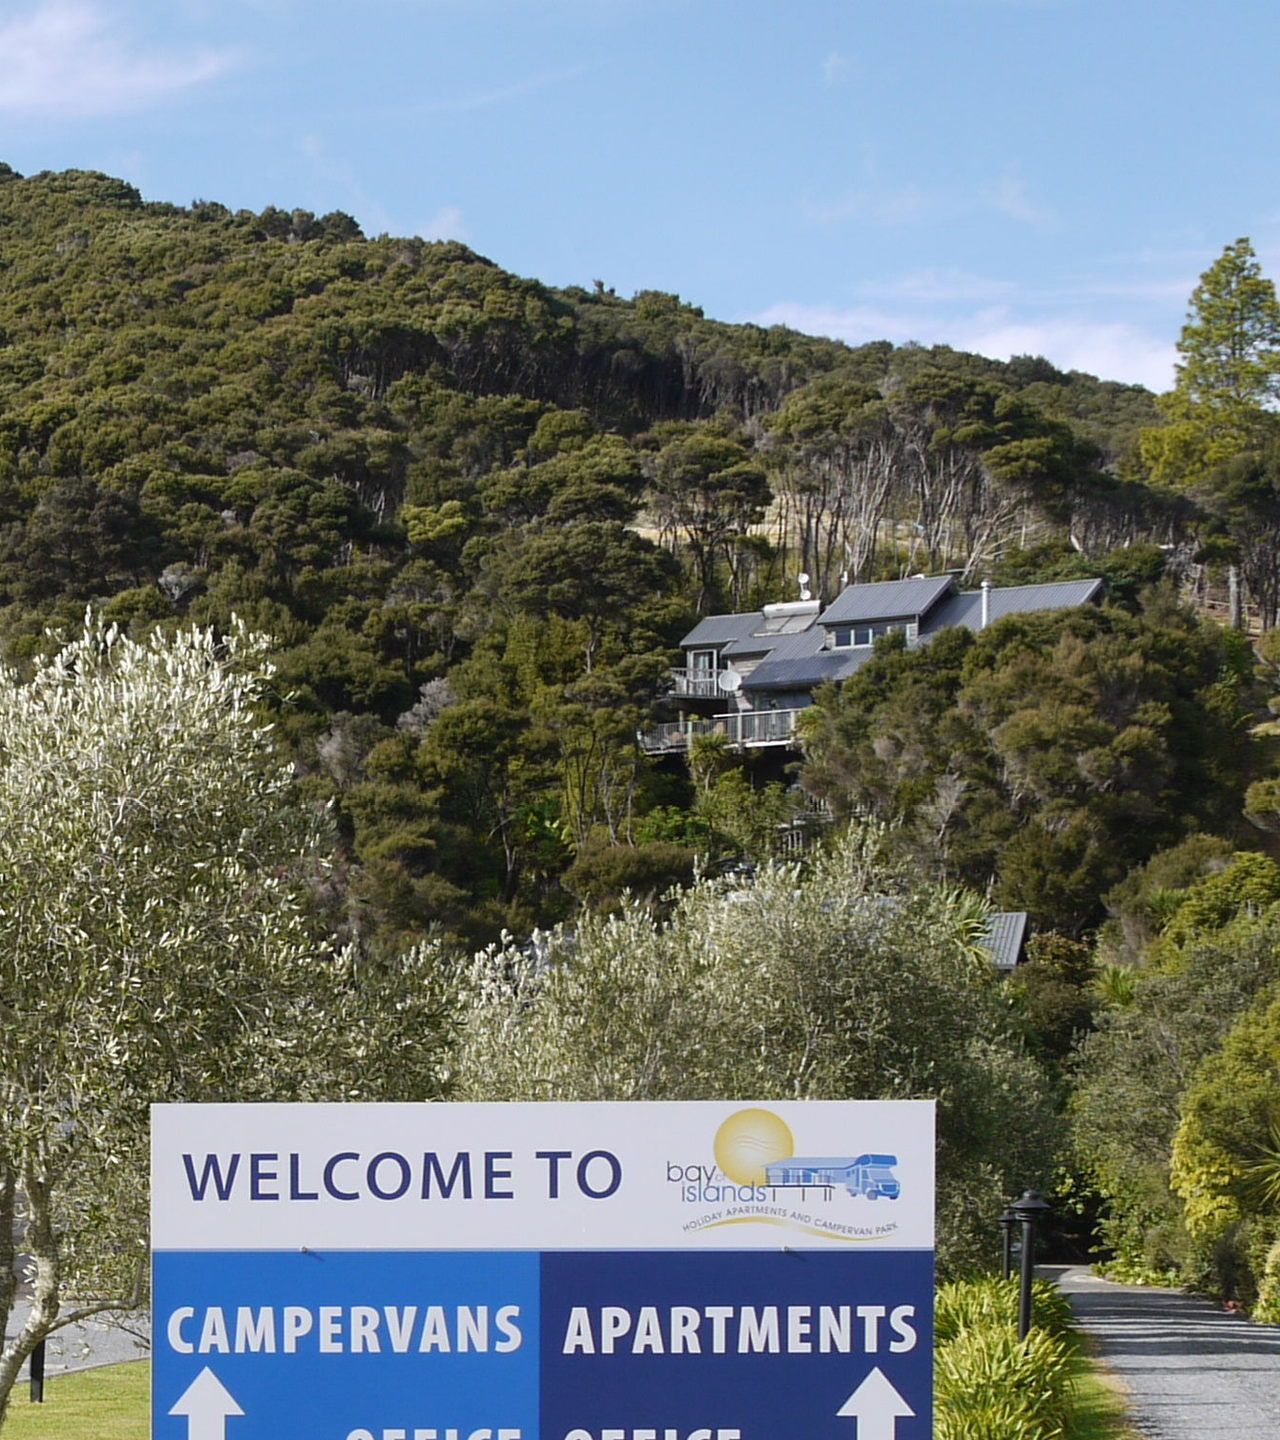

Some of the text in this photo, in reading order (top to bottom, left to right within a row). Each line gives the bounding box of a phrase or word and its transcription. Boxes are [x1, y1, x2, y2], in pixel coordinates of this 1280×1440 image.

[182, 1150, 622, 1201] WELCOME TO
[667, 1161, 717, 1186] bay
[681, 1180, 767, 1202] islands
[683, 1206, 898, 1235] HOLIDAY APARTMENTS AND CAMPERVAN PARK
[167, 1305, 522, 1354] CAMPERVANS
[562, 1305, 917, 1354] APARTMENTS
